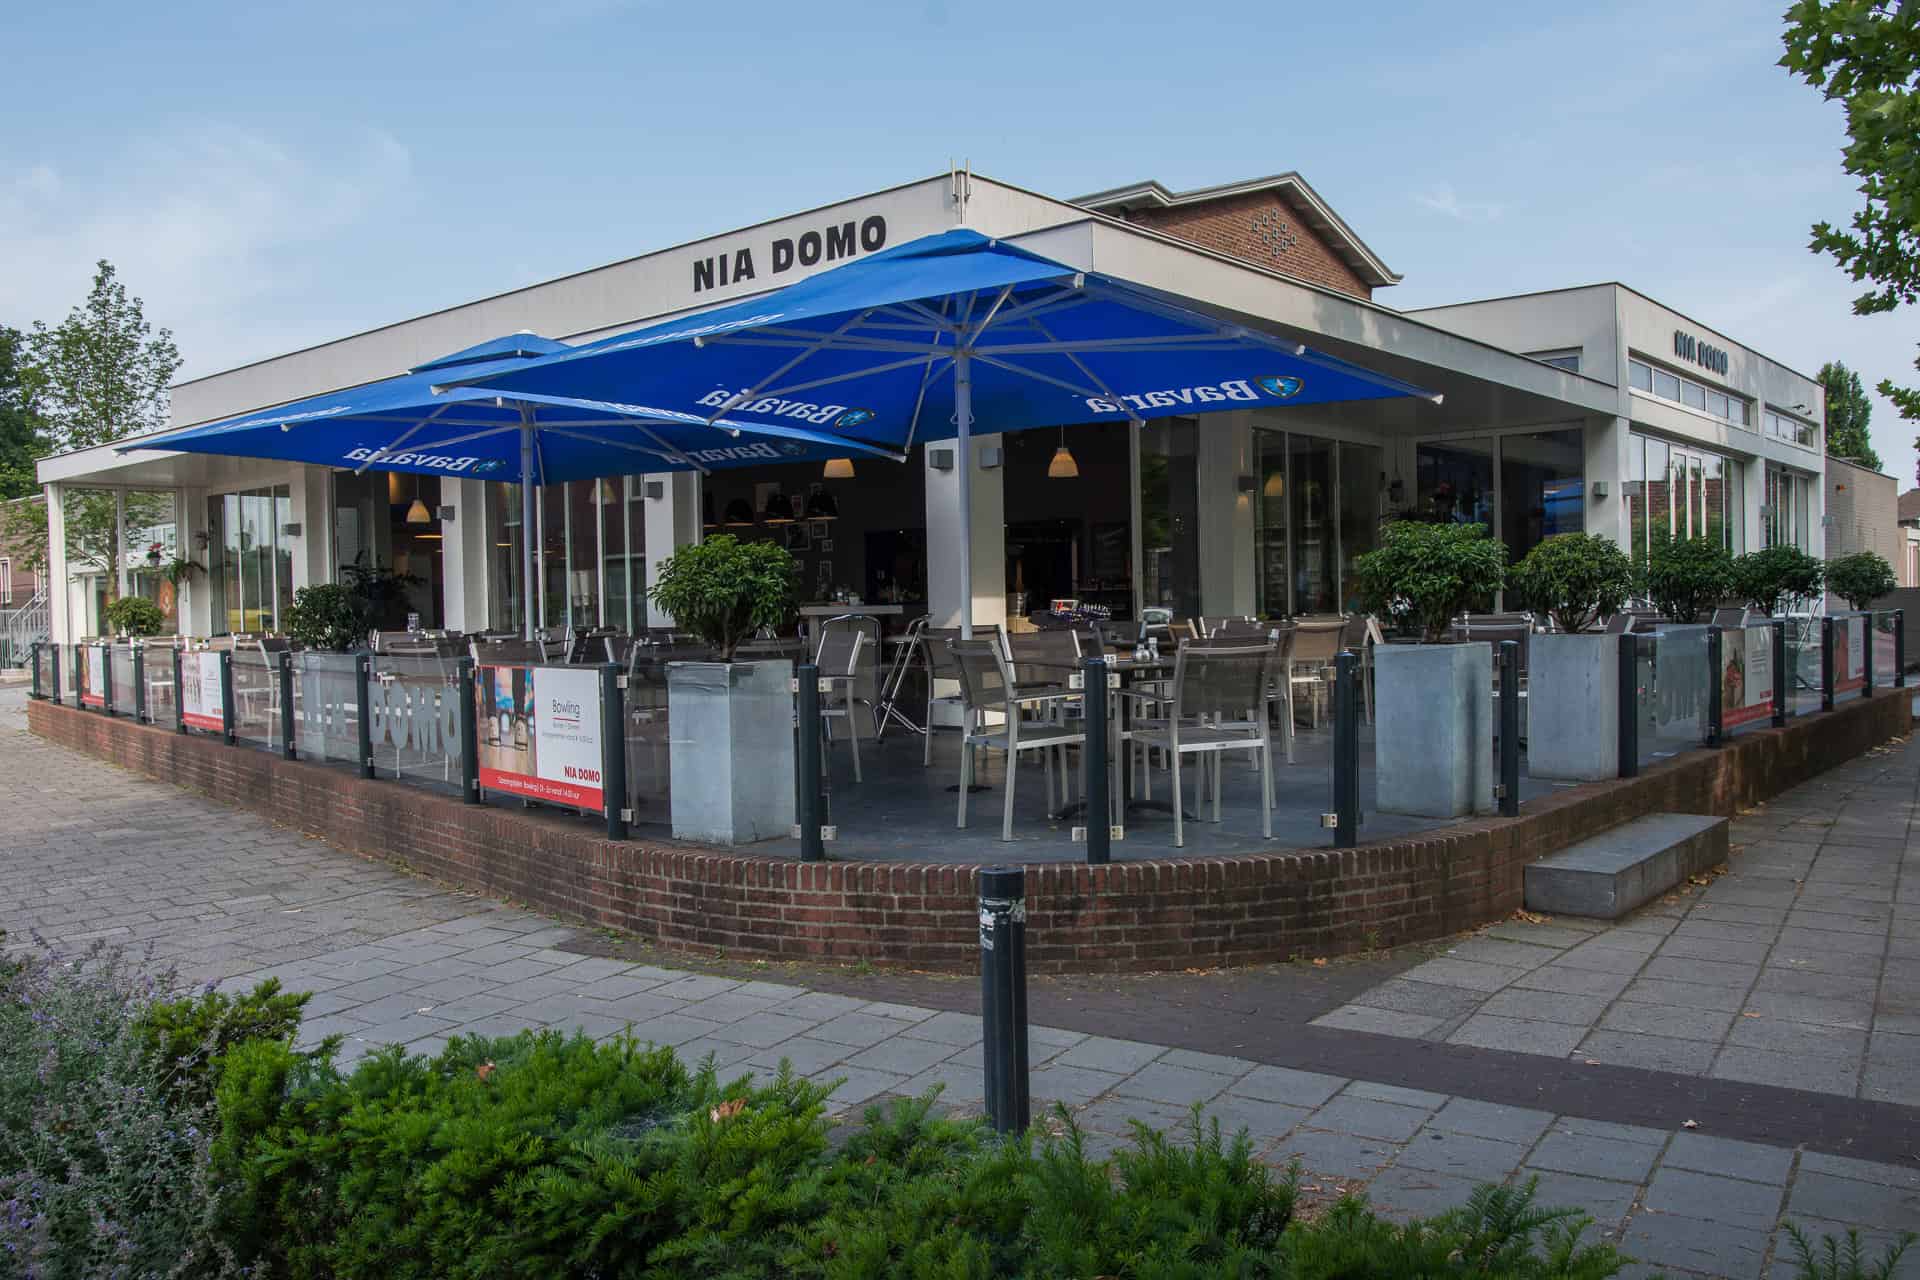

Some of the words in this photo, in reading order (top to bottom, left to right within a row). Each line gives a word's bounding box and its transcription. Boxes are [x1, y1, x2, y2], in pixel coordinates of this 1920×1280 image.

[693, 248, 756, 293] NIA
[771, 215, 887, 274] DOMO
[1674, 330, 1696, 363] NIA
[1697, 341, 1729, 376] DOMO
[368, 680, 462, 758] DOMO
[552, 698, 580, 718] Bowling
[564, 766, 577, 779] NIA
[578, 768, 600, 783] DOMO
